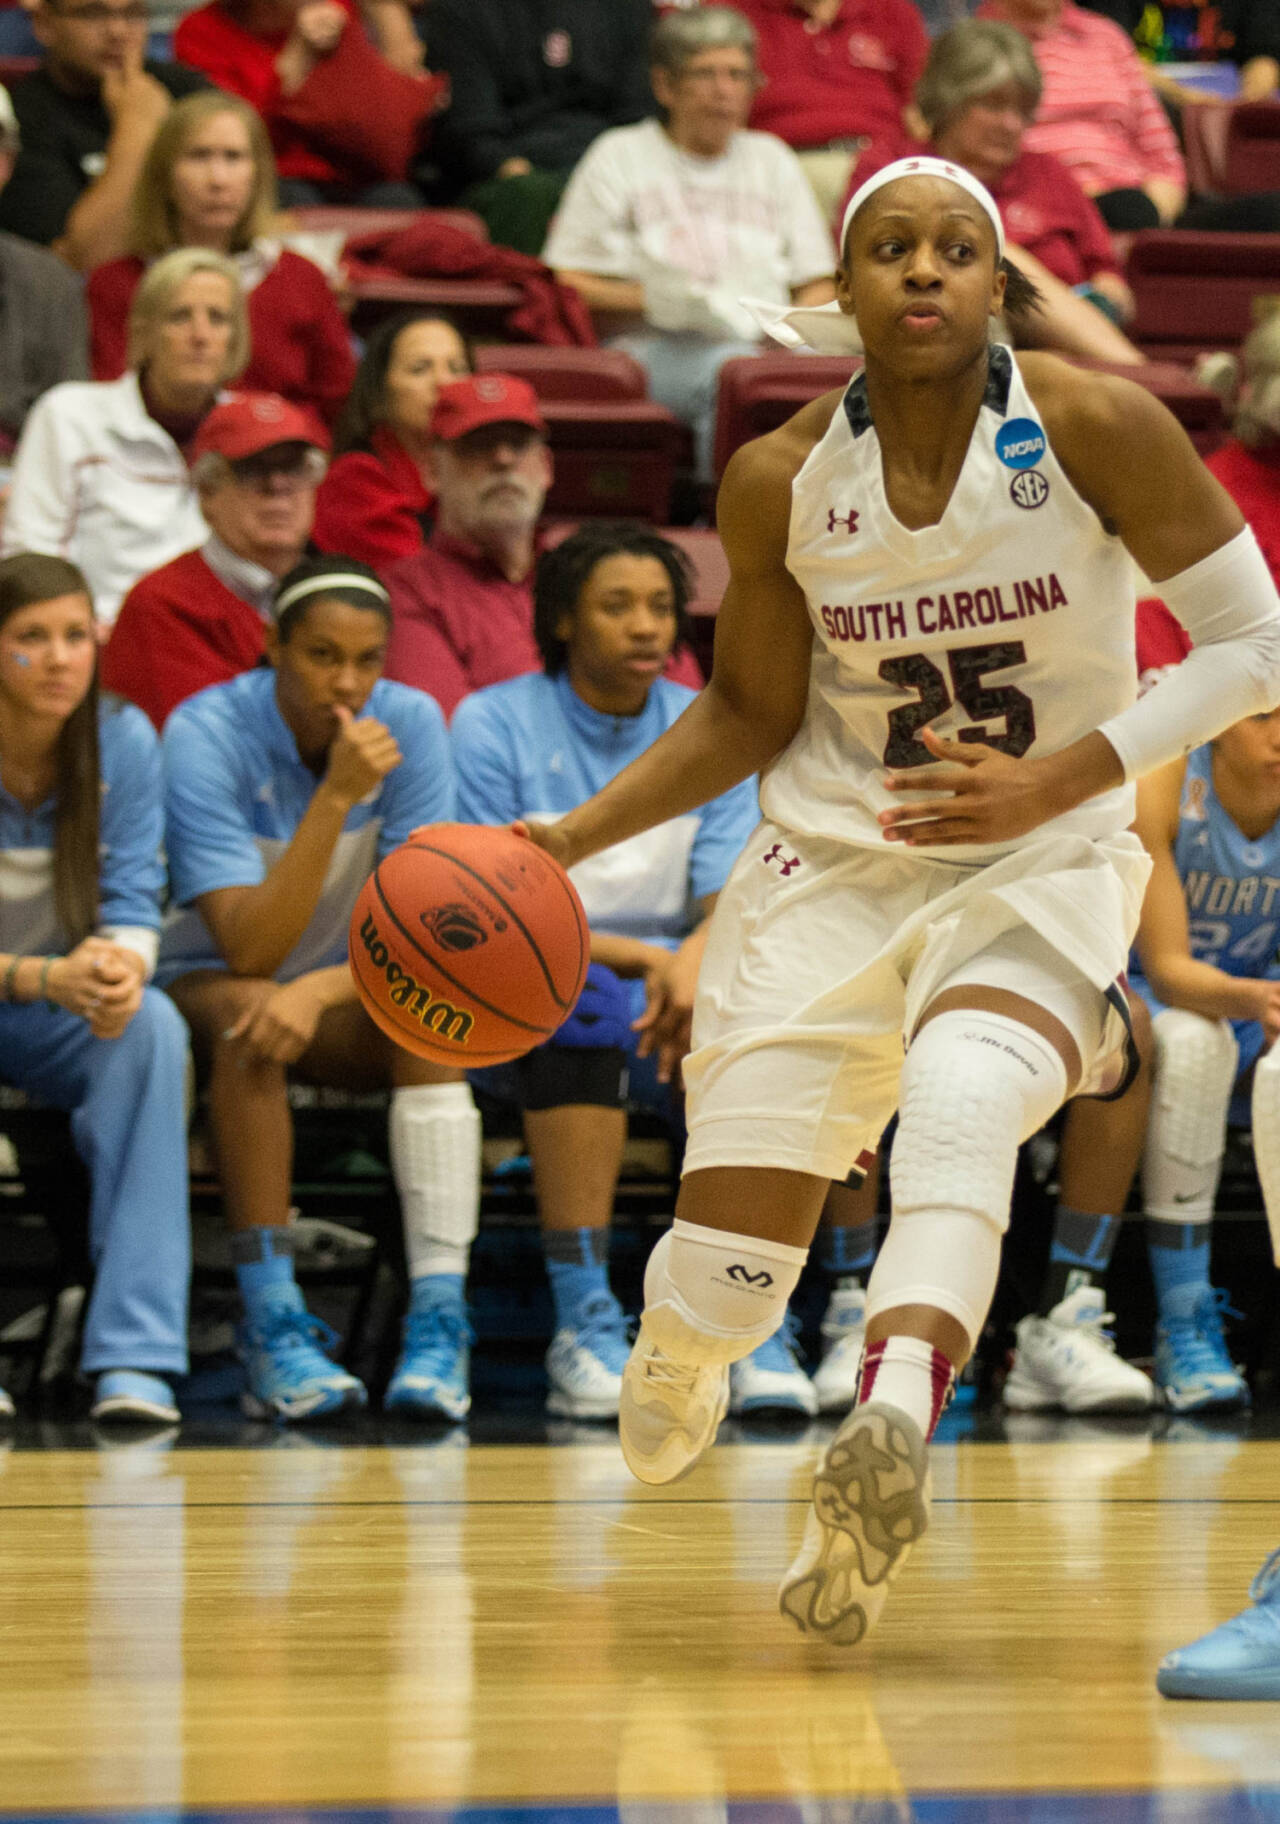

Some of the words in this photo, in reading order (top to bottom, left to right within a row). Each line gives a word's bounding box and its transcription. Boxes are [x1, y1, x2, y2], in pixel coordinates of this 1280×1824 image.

[1003, 437, 1044, 460] NCAA
[1012, 471, 1047, 507] SEC
[821, 602, 908, 642] SOUTH
[915, 573, 1069, 634] CAROLINA
[877, 640, 1037, 770] 25
[360, 908, 475, 1045] Wilson
